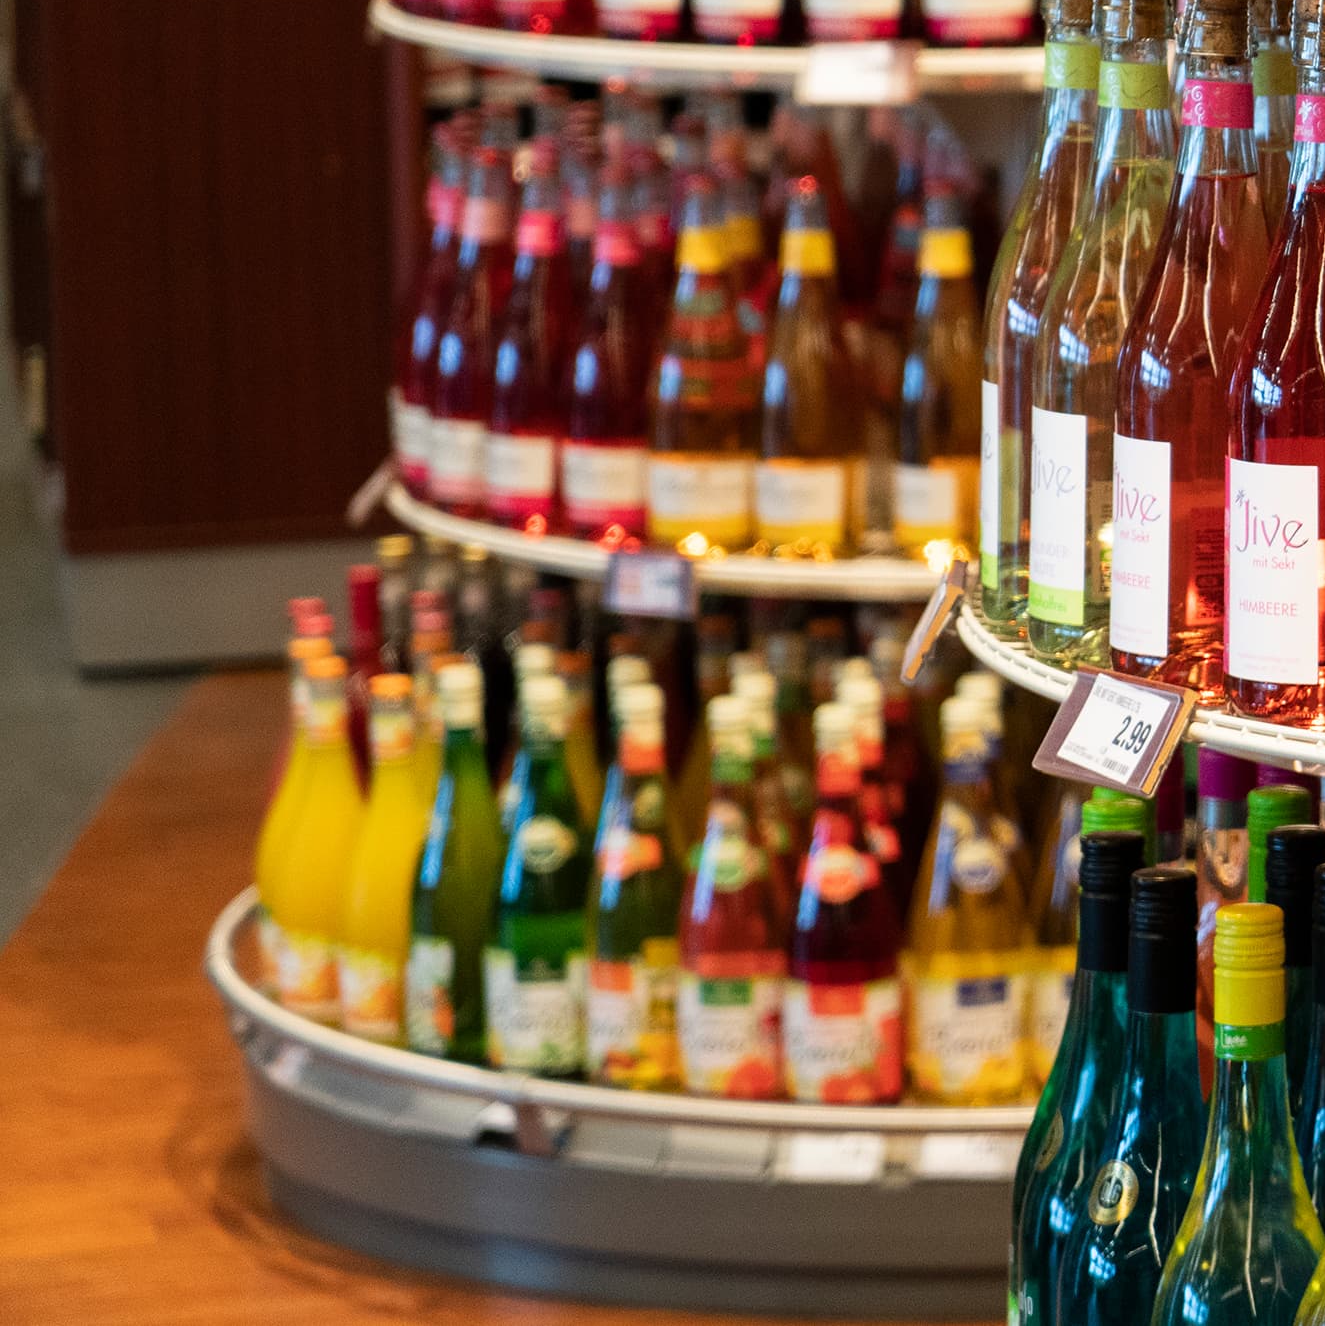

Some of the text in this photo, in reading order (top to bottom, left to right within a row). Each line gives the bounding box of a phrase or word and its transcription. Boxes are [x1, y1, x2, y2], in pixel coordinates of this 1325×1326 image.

[1235, 499, 1309, 553] Jive
[1253, 556, 1295, 571] mit Sekt
[1239, 600, 1297, 617] HIMBEERE
[1112, 716, 1151, 754] 2.99
